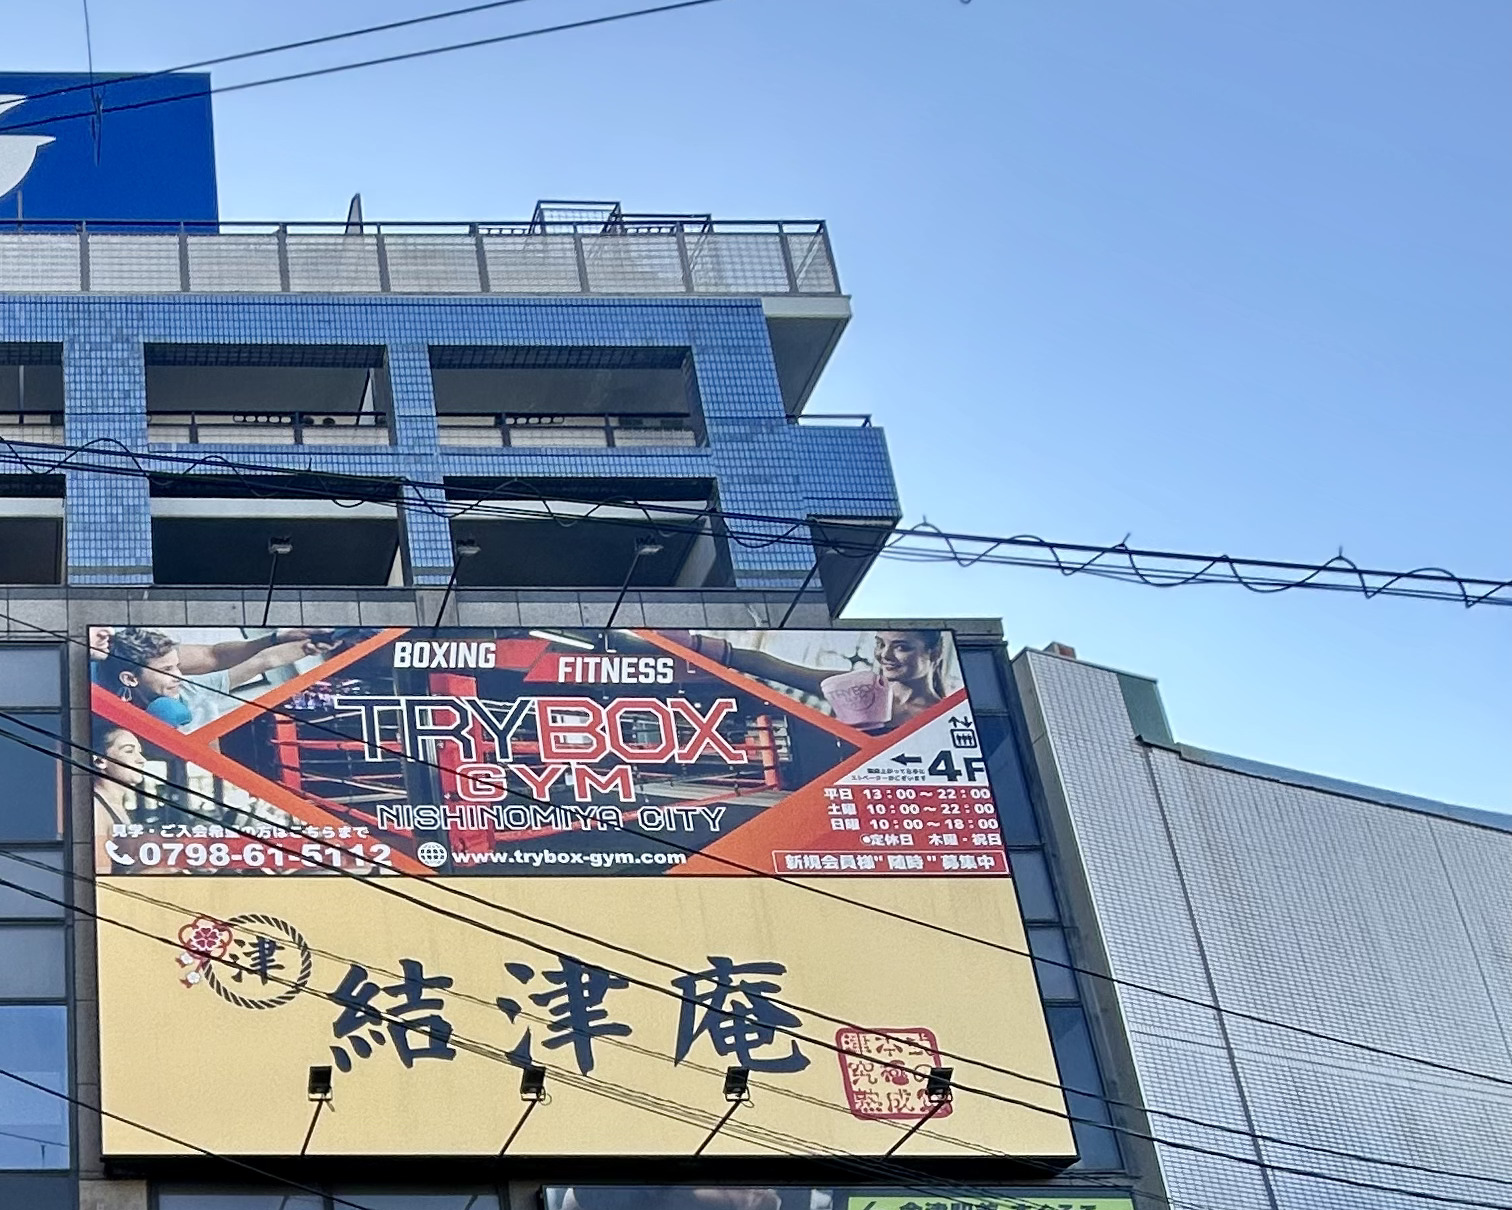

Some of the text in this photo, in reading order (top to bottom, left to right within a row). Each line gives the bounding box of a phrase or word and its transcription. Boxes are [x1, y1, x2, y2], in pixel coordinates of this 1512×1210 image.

[393, 641, 674, 684] BOXING FITNESS
[335, 696, 748, 764] TRYBOX
[928, 750, 986, 782] 4F
[456, 763, 636, 802] GYM
[823, 788, 853, 800] 平日
[376, 804, 727, 832] NISHINOMIYA CITY
[828, 804, 857, 815] 土曜
[831, 819, 860, 831] 日曜
[871, 833, 914, 846] 定休日
[139, 843, 393, 867] 0798-61-5112
[451, 849, 687, 868] www.trybox-gym.com
[228, 935, 286, 986] 津
[326, 955, 809, 1077] 結津庵
